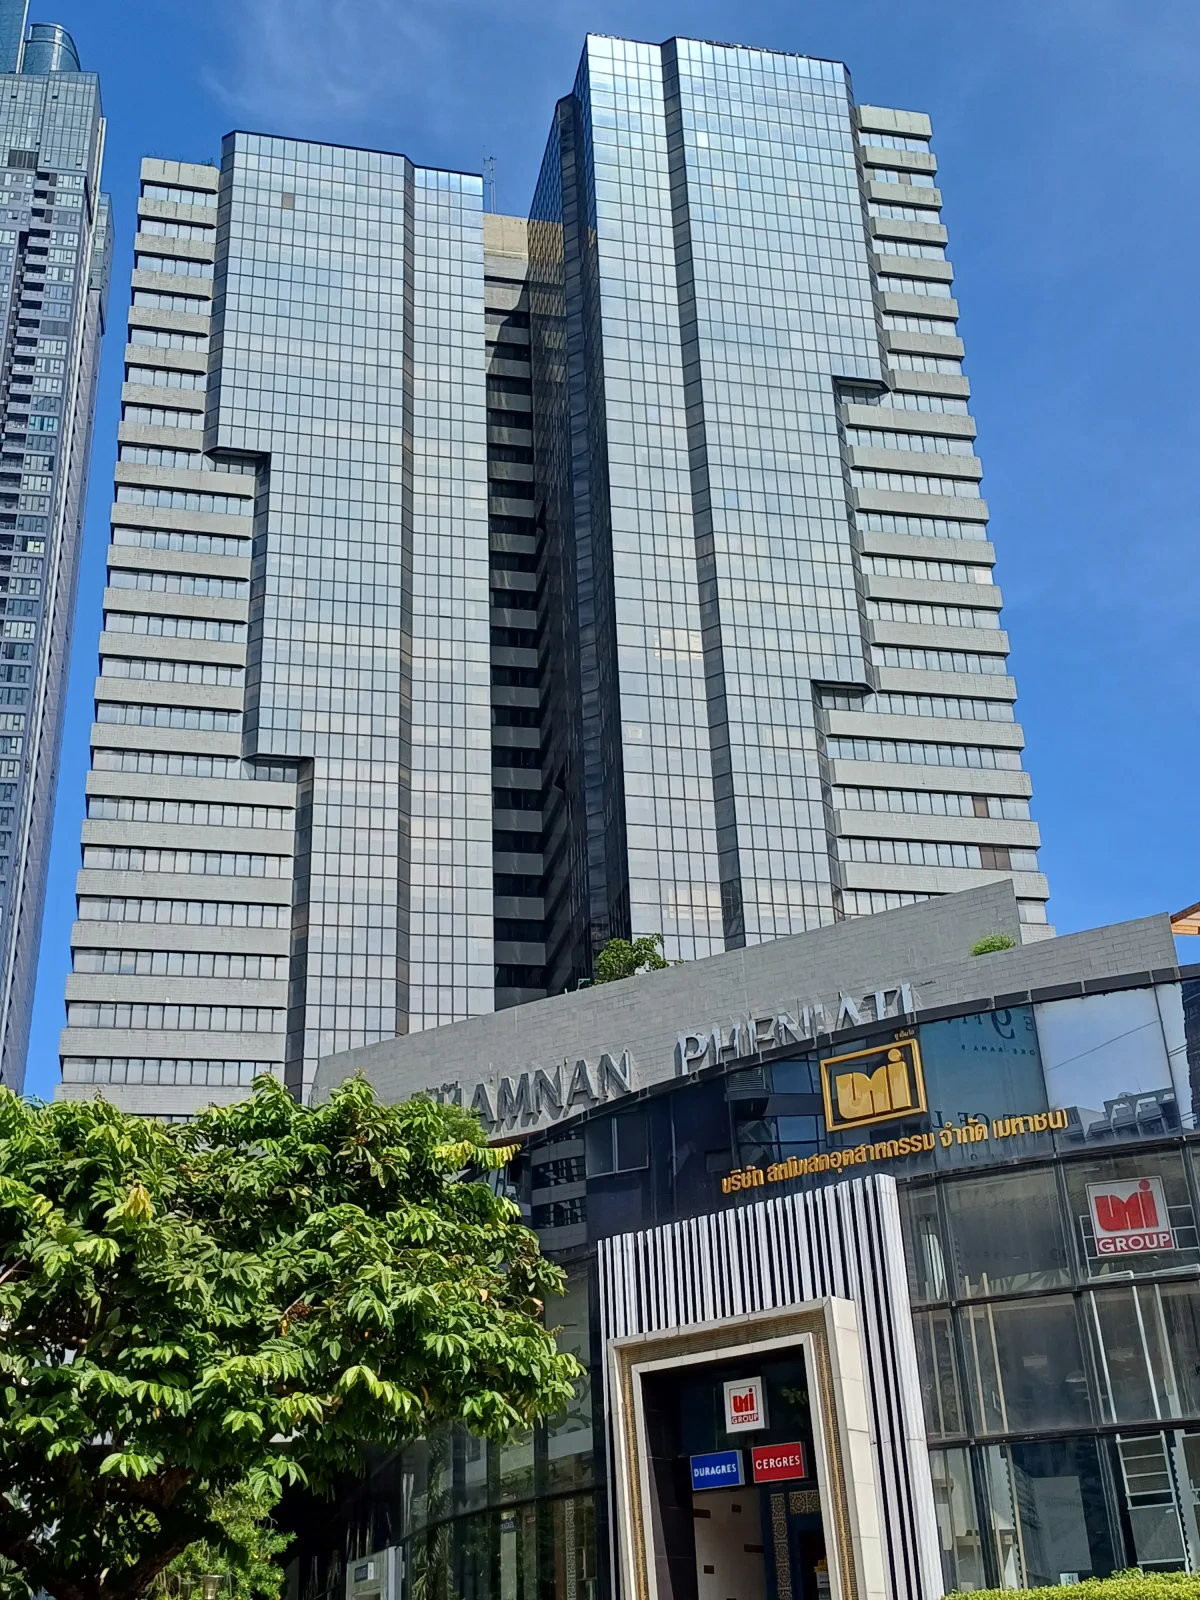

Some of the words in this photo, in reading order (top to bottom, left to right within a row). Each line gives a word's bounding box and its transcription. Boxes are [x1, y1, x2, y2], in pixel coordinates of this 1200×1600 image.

[437, 1050, 632, 1123] AMNAN
[721, 1165, 765, 1194] บริษัท
[939, 1118, 989, 1148] จำกัด
[992, 1109, 1068, 1141] (มหาชน)
[1099, 1233, 1170, 1252] GROUP
[731, 1414, 759, 1424] GROUP
[693, 1463, 737, 1478] DURAGRES
[755, 1455, 801, 1470] CERGRES
